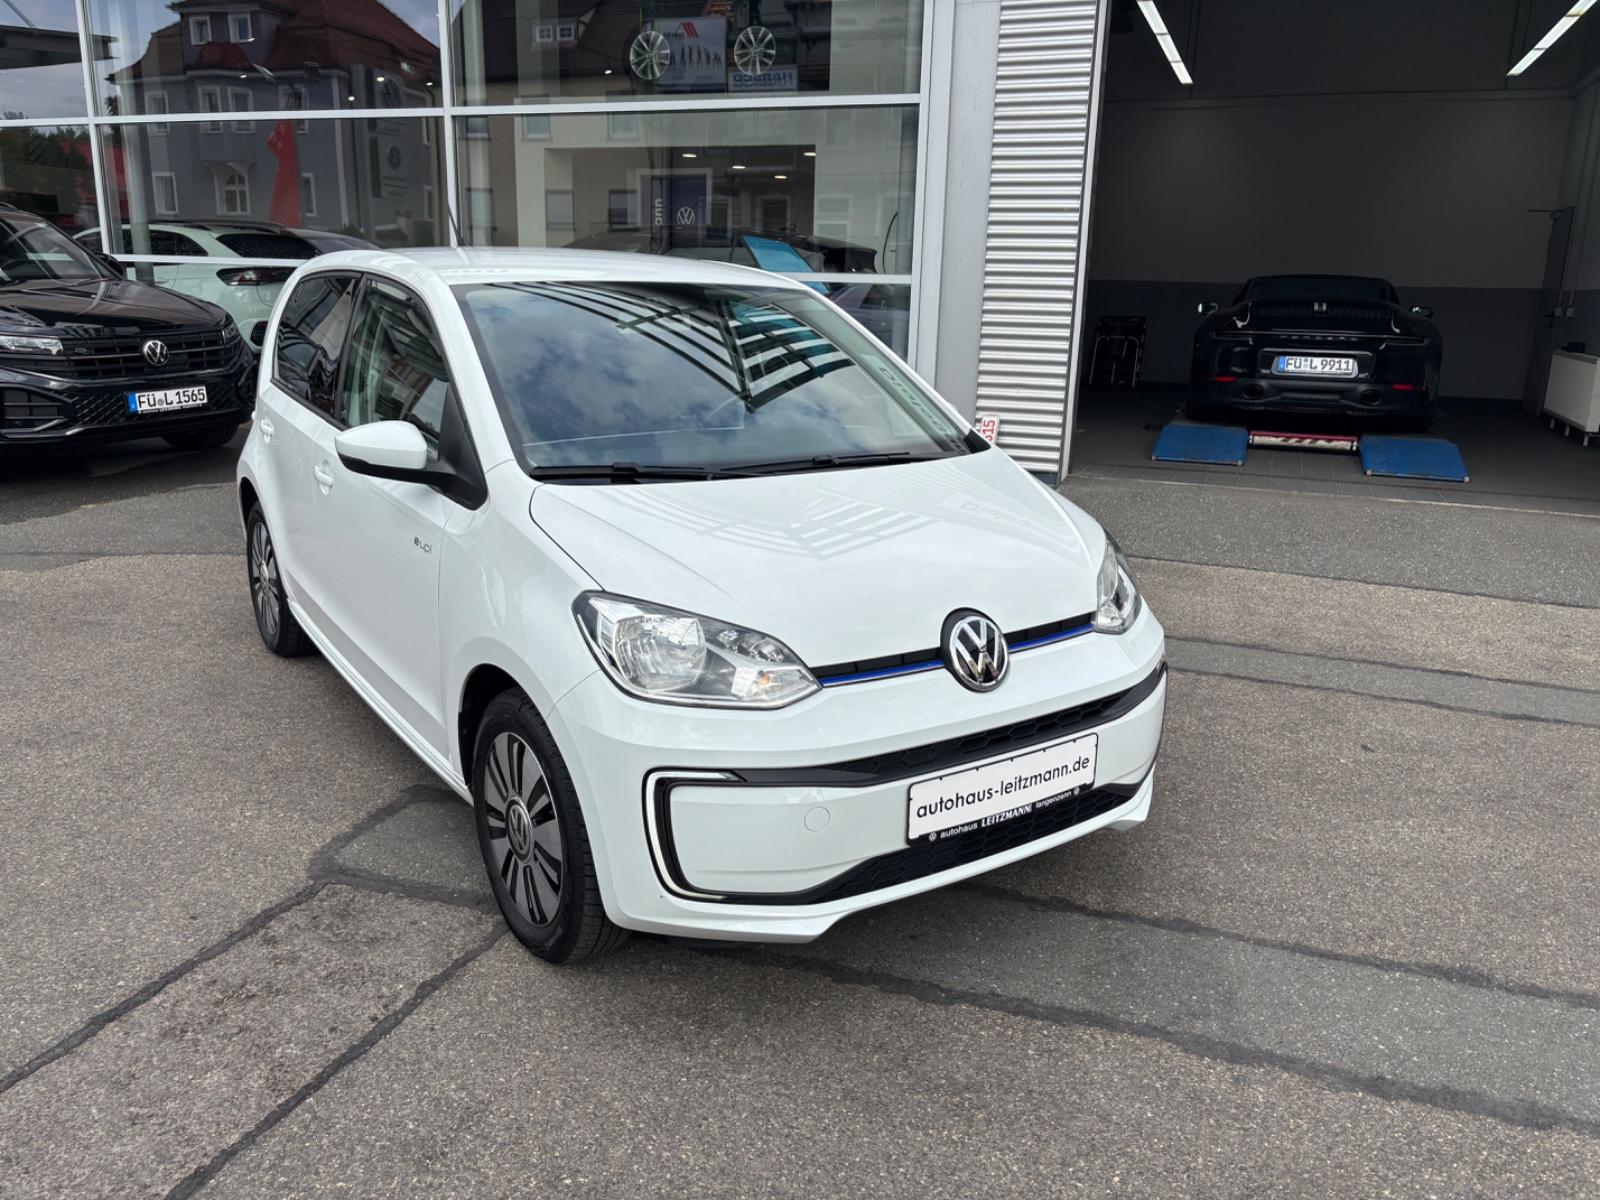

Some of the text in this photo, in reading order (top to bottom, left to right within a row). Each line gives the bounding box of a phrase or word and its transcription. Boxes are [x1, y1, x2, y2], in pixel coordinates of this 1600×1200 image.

[1320, 359, 1351, 371] 9911
[164, 392, 173, 406] L
[175, 388, 206, 405] 1565
[916, 756, 1090, 818] autohaus-leitzmann.de
[940, 822, 978, 839] autohaus
[981, 805, 1032, 828] LEITZMANN
